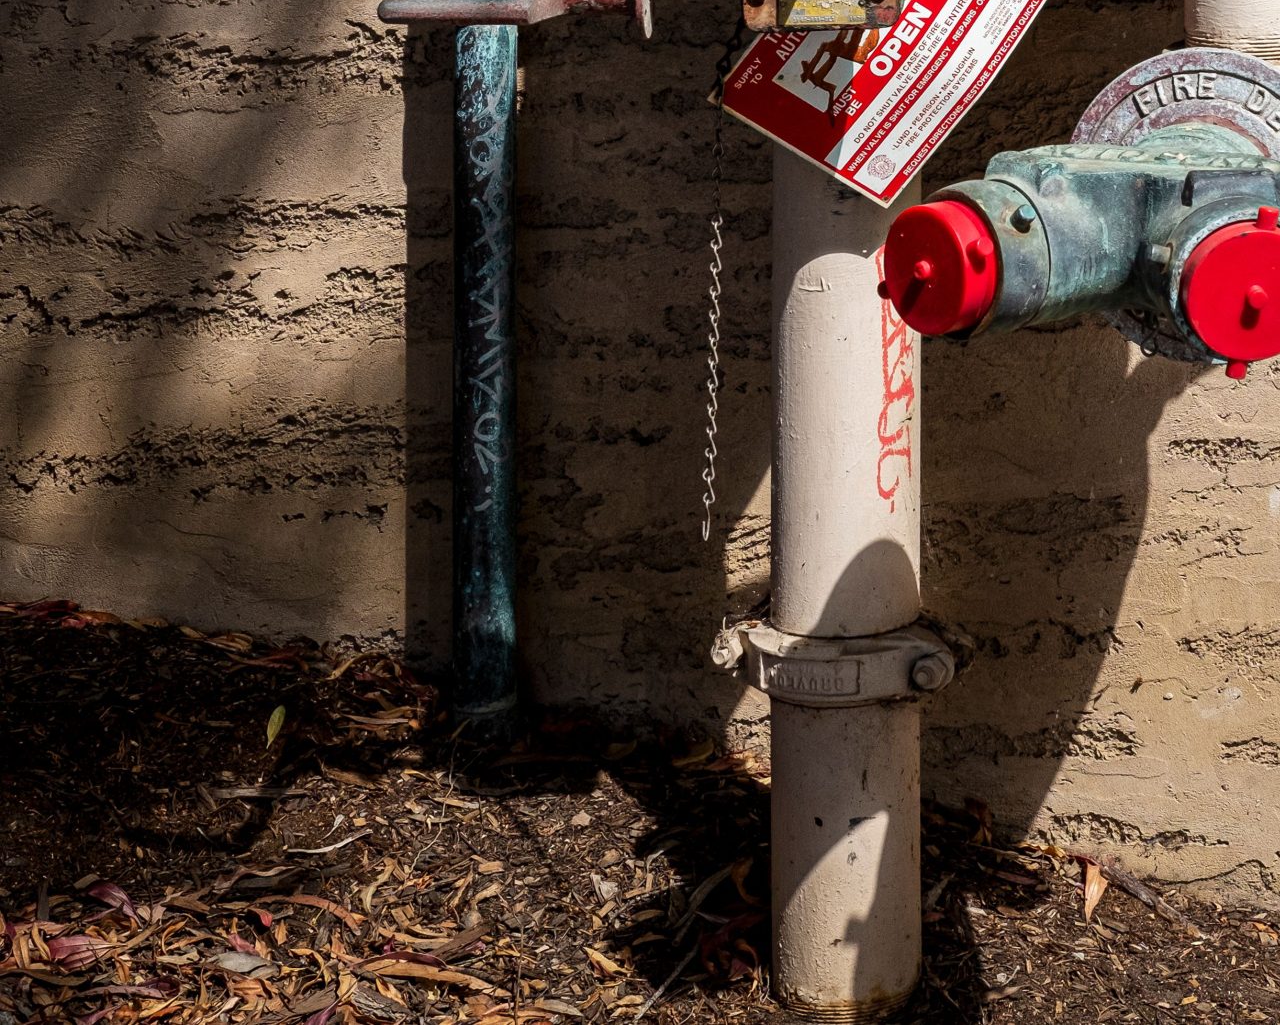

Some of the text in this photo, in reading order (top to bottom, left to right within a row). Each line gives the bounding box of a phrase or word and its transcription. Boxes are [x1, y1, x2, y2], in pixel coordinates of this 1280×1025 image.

[733, 56, 762, 90] SUPPLY
[866, 0, 933, 81] OPEN
[895, 21, 941, 80] IN CASE OF FIRE
[749, 71, 763, 86] TO
[829, 85, 857, 117] MUST
[845, 98, 863, 117] BE
[847, 150, 868, 172] WHEN
[864, 127, 886, 152] VALVE
[883, 120, 892, 130] IS
[888, 102, 907, 122] SHUT
[904, 87, 919, 104] FOR
[916, 45, 952, 90] EMERGENCY
[952, 8, 977, 41] REPAIRS
[853, 131, 865, 144] DO
[862, 115, 878, 133] NOT
[875, 96, 894, 117] SHUT
[891, 73, 913, 98] VALVE
[910, 52, 930, 74] UNTIL
[926, 34, 942, 53] FIRE
[938, 25, 948, 36] IS
[892, 46, 975, 149] LUND PEARSON McLAUGHLIN
[902, 143, 931, 176] REQUEST
[986, 24, 1021, 71] PROTECTION
[904, 57, 978, 147] FIRE PROTECTION SYSTEMS
[1132, 72, 1217, 118] FIRE
